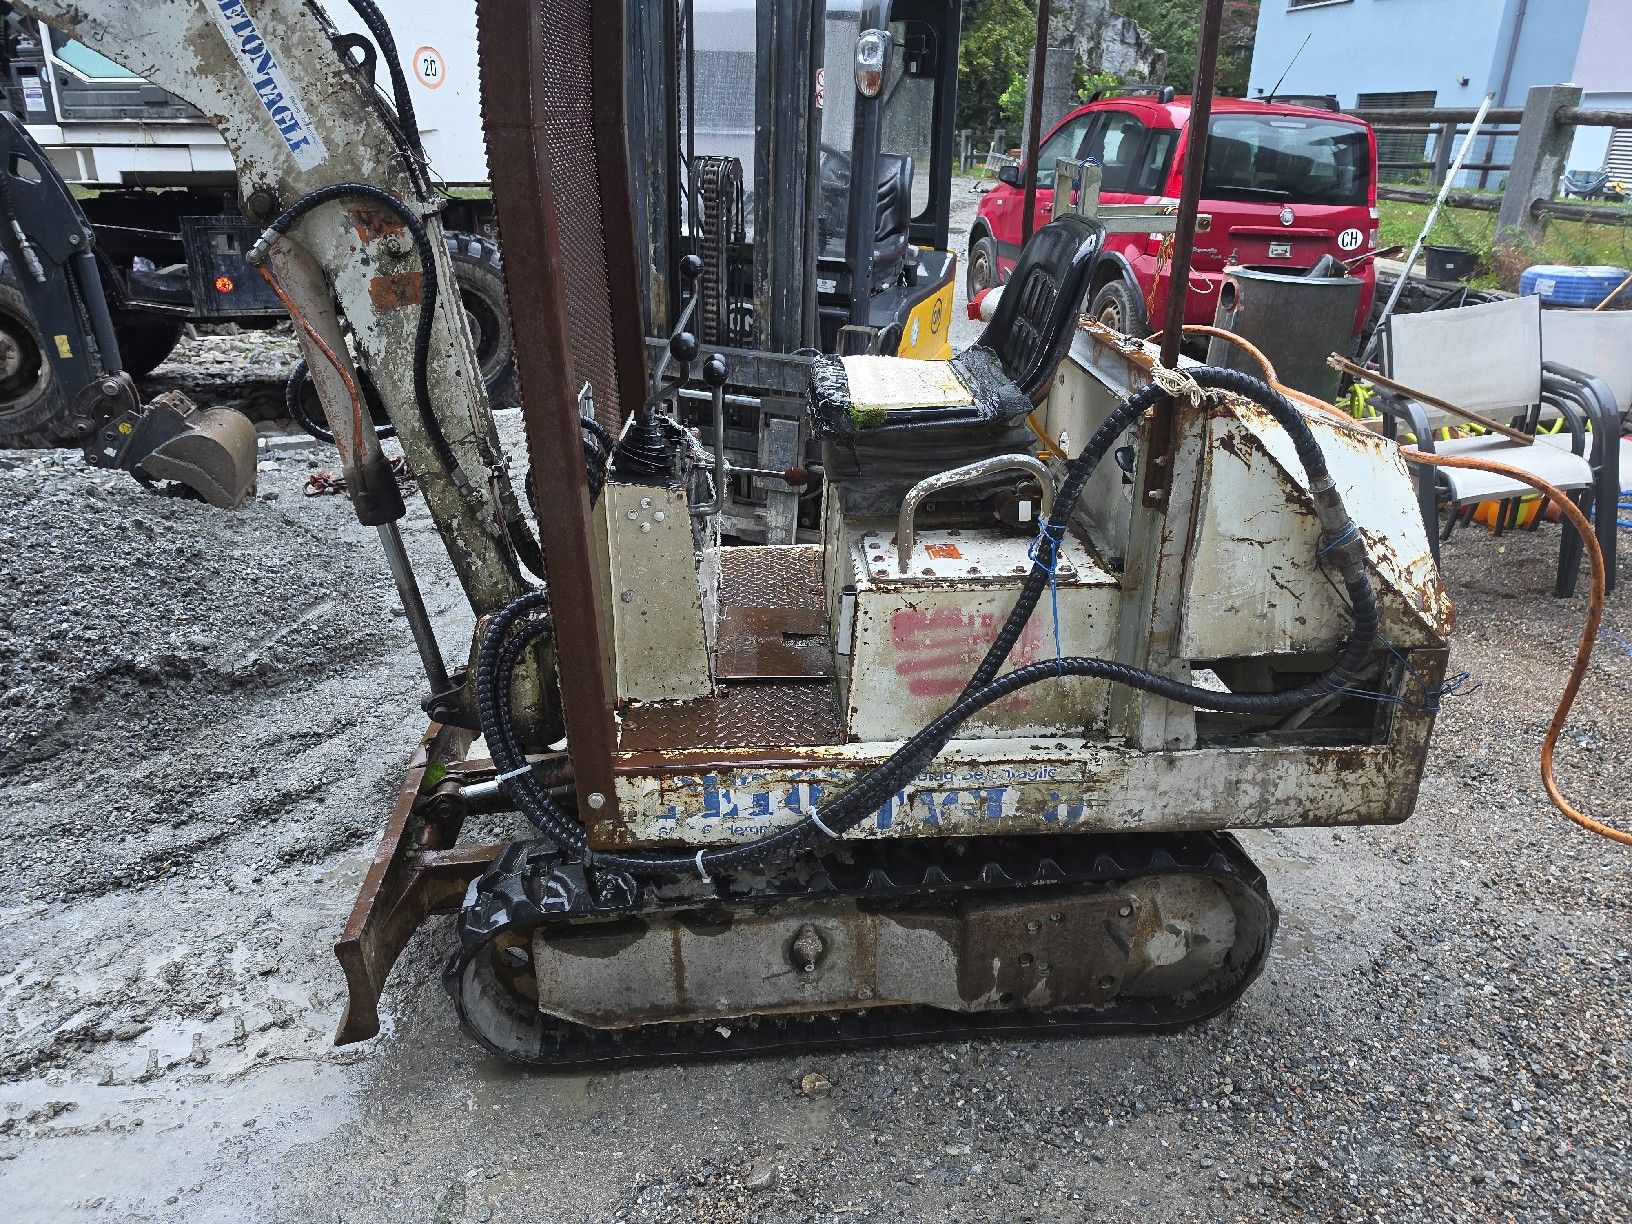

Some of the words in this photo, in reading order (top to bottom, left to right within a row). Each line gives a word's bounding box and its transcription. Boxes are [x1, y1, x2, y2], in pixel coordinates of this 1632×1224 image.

[217, 0, 311, 154] ETONTAGLI
[423, 58, 437, 77] 20
[1341, 231, 1358, 248] CH
